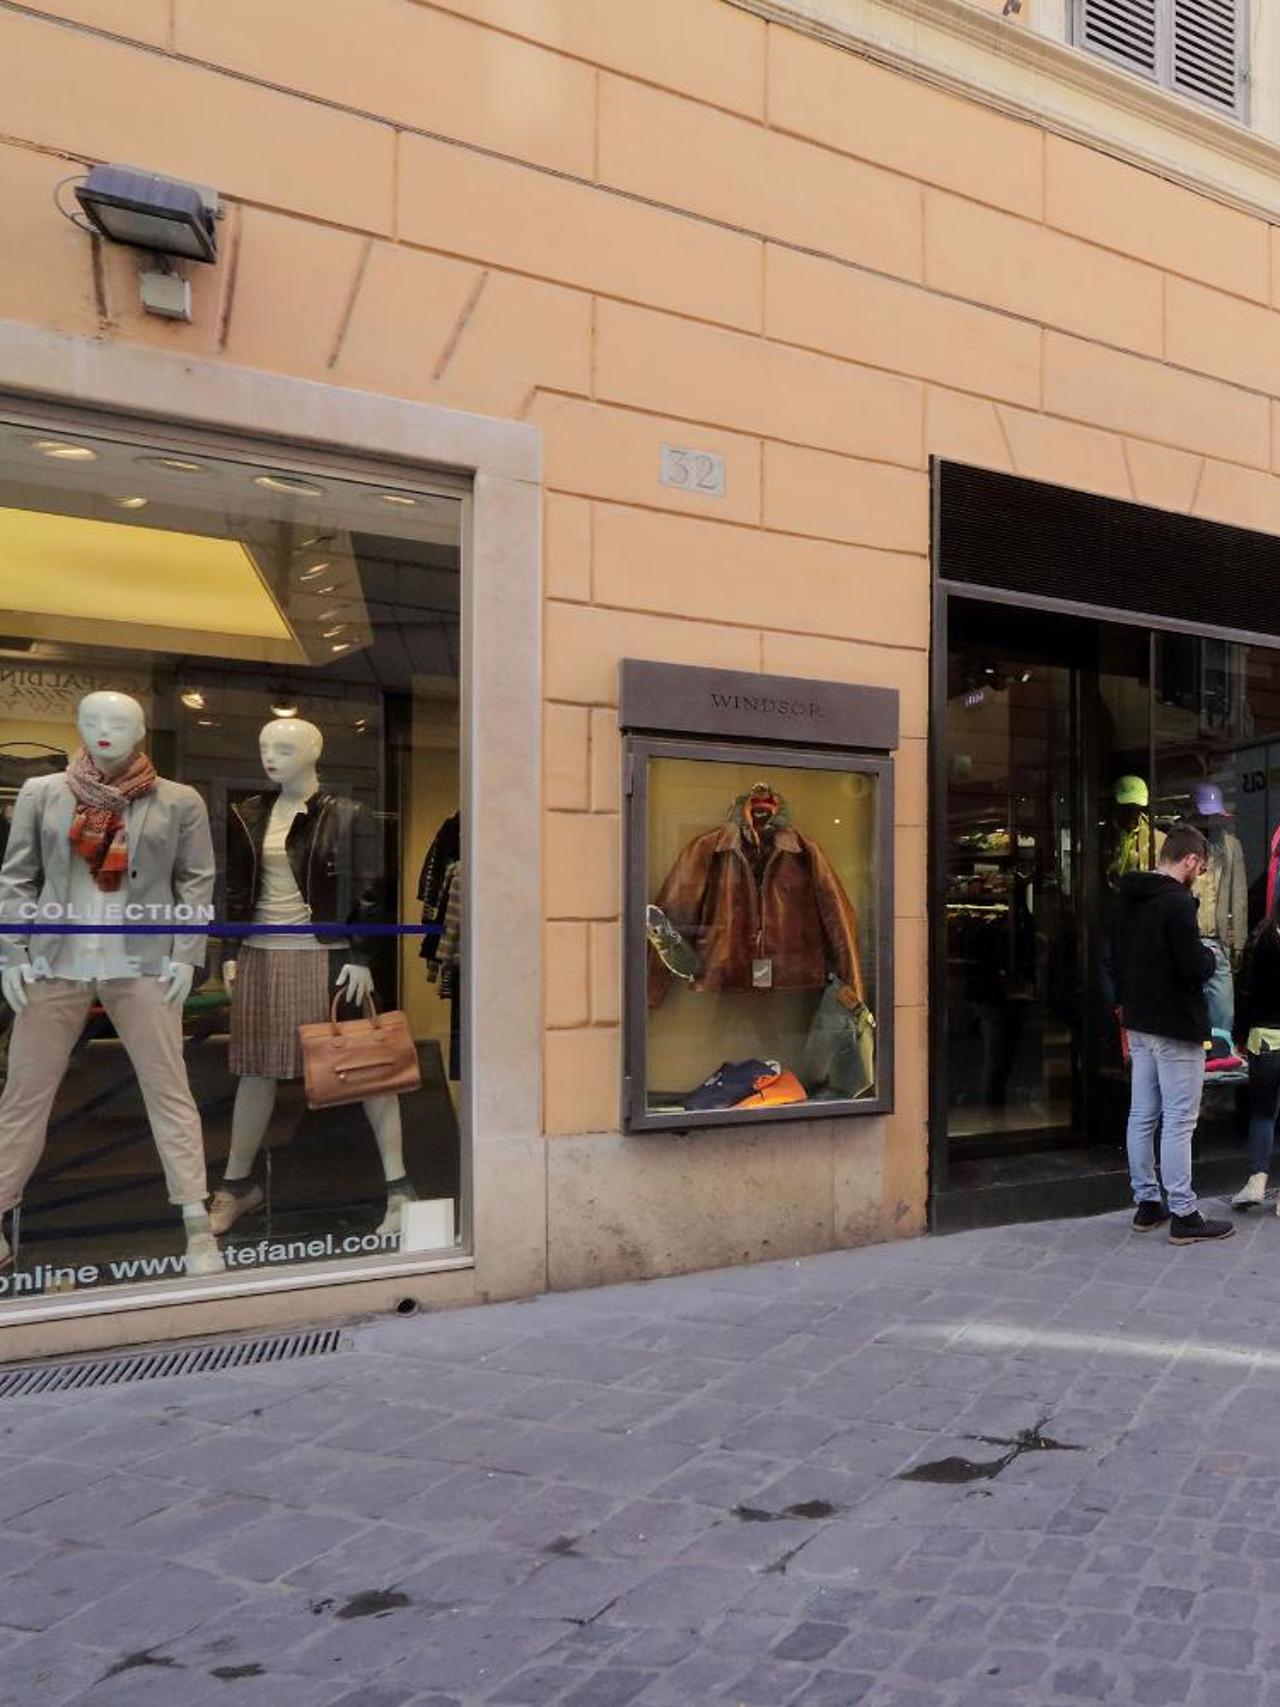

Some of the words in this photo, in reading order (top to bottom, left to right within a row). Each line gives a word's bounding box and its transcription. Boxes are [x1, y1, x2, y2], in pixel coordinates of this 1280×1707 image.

[668, 449, 716, 489] 32
[710, 693, 825, 718] WINDSOR
[19, 902, 215, 921] COLLECTION
